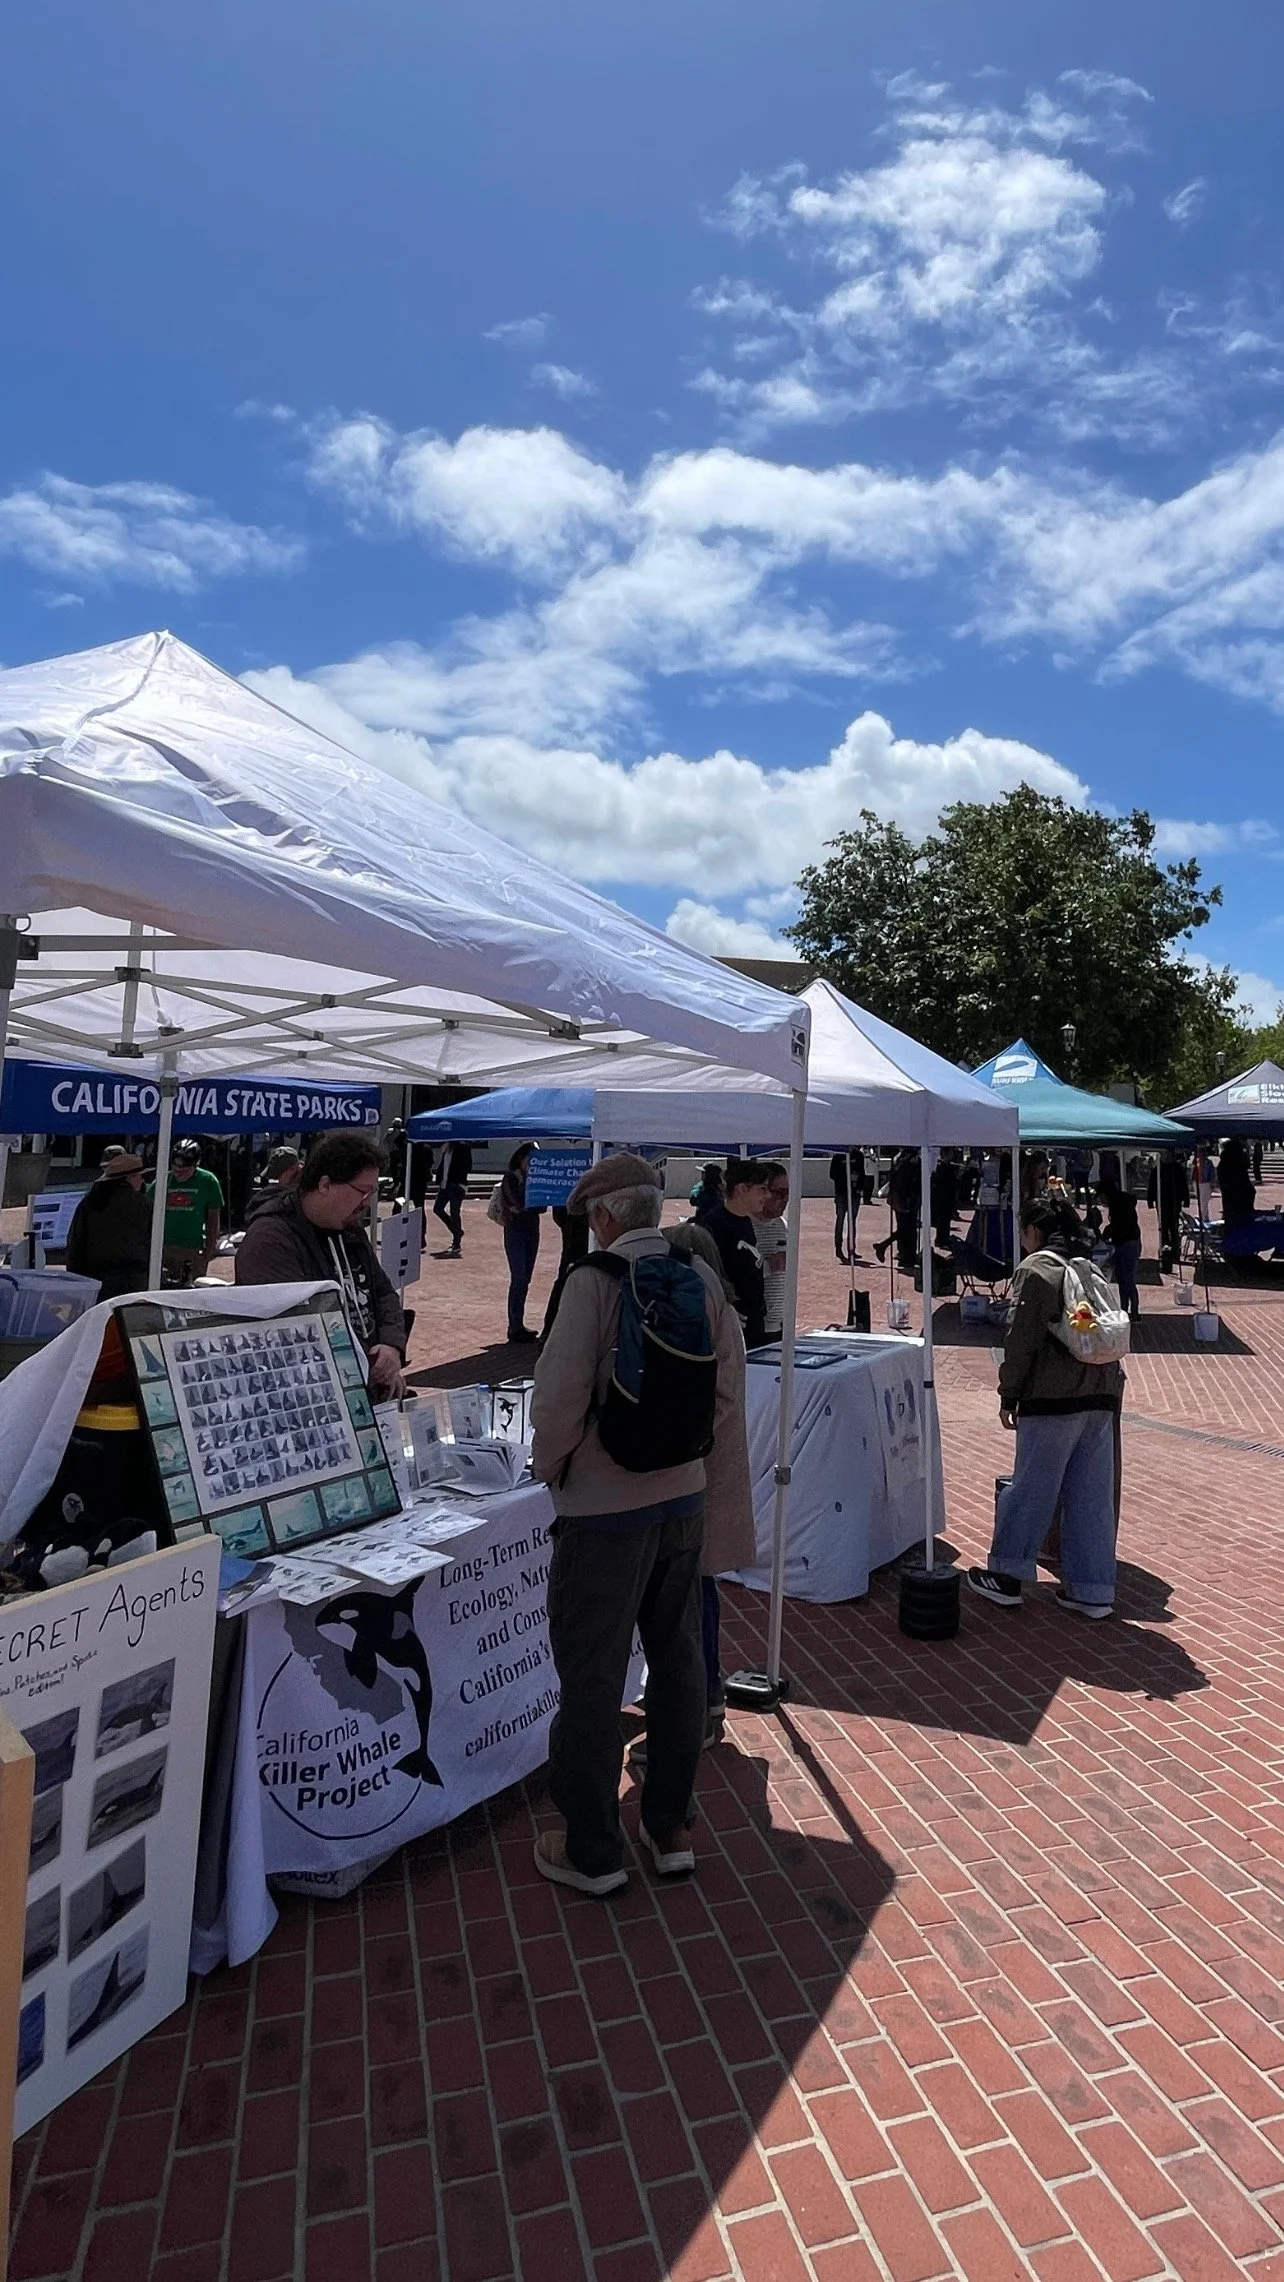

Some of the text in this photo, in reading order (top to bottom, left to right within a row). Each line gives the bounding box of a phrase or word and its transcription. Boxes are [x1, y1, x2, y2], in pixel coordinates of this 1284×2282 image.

[51, 1081, 363, 1122] CALIFONIA STATE PARKS
[528, 1166, 565, 1176] Climate
[530, 1157, 548, 1166] Our
[550, 1158, 587, 1167] Solution
[439, 1538, 530, 1589] Long-Term
[98, 1566, 206, 1648] Agents
[447, 1582, 519, 1626] Ecology,
[476, 1620, 511, 1656] and
[459, 1639, 551, 1705] California's
[336, 1730, 402, 1776] Whale
[296, 1764, 392, 1812] Project
